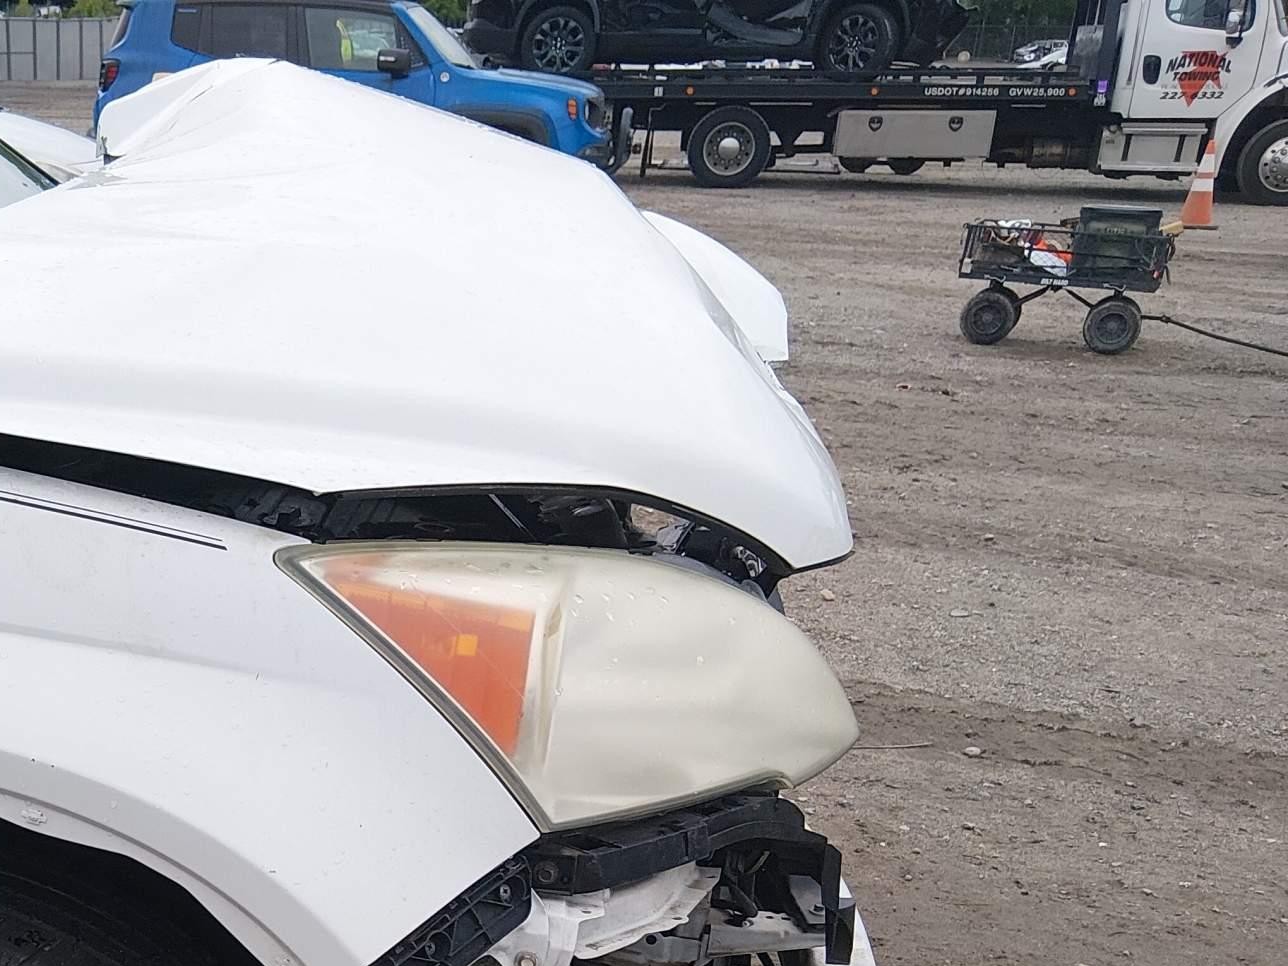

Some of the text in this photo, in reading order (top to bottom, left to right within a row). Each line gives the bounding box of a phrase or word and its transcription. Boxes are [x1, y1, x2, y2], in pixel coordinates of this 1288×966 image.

[1165, 52, 1232, 74] NATIONAL
[1172, 71, 1221, 82] TOWING
[1008, 87, 1066, 97] GVW25,900
